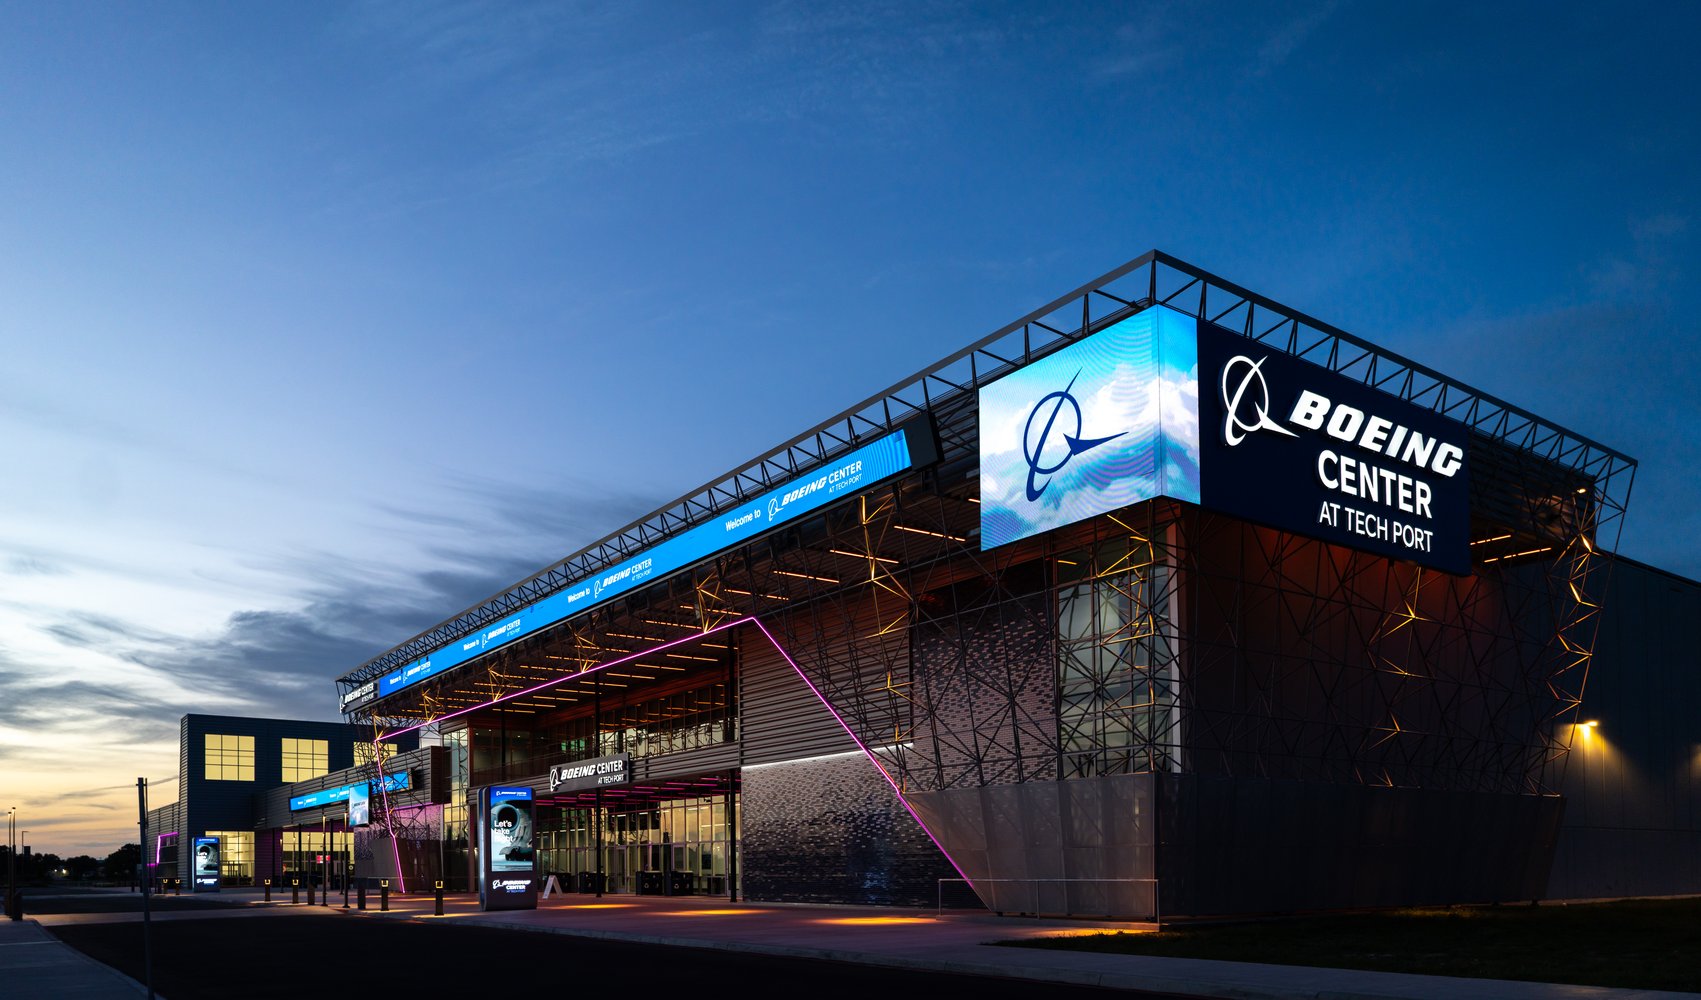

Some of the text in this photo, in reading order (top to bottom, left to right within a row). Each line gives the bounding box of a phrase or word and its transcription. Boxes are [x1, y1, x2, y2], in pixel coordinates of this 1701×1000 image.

[1289, 389, 1464, 478] BOEING
[725, 460, 862, 532] Welcome to BOEING CENTER
[828, 473, 862, 494] AT TECH PORT
[1318, 449, 1432, 518] CENTER
[1319, 501, 1433, 552] AT TECH PORT
[567, 558, 652, 603] Welcome to BOEING CENTER
[560, 760, 623, 780] BOEING CENTER
[603, 775, 614, 784] TECH
[614, 774, 624, 782] PORT
